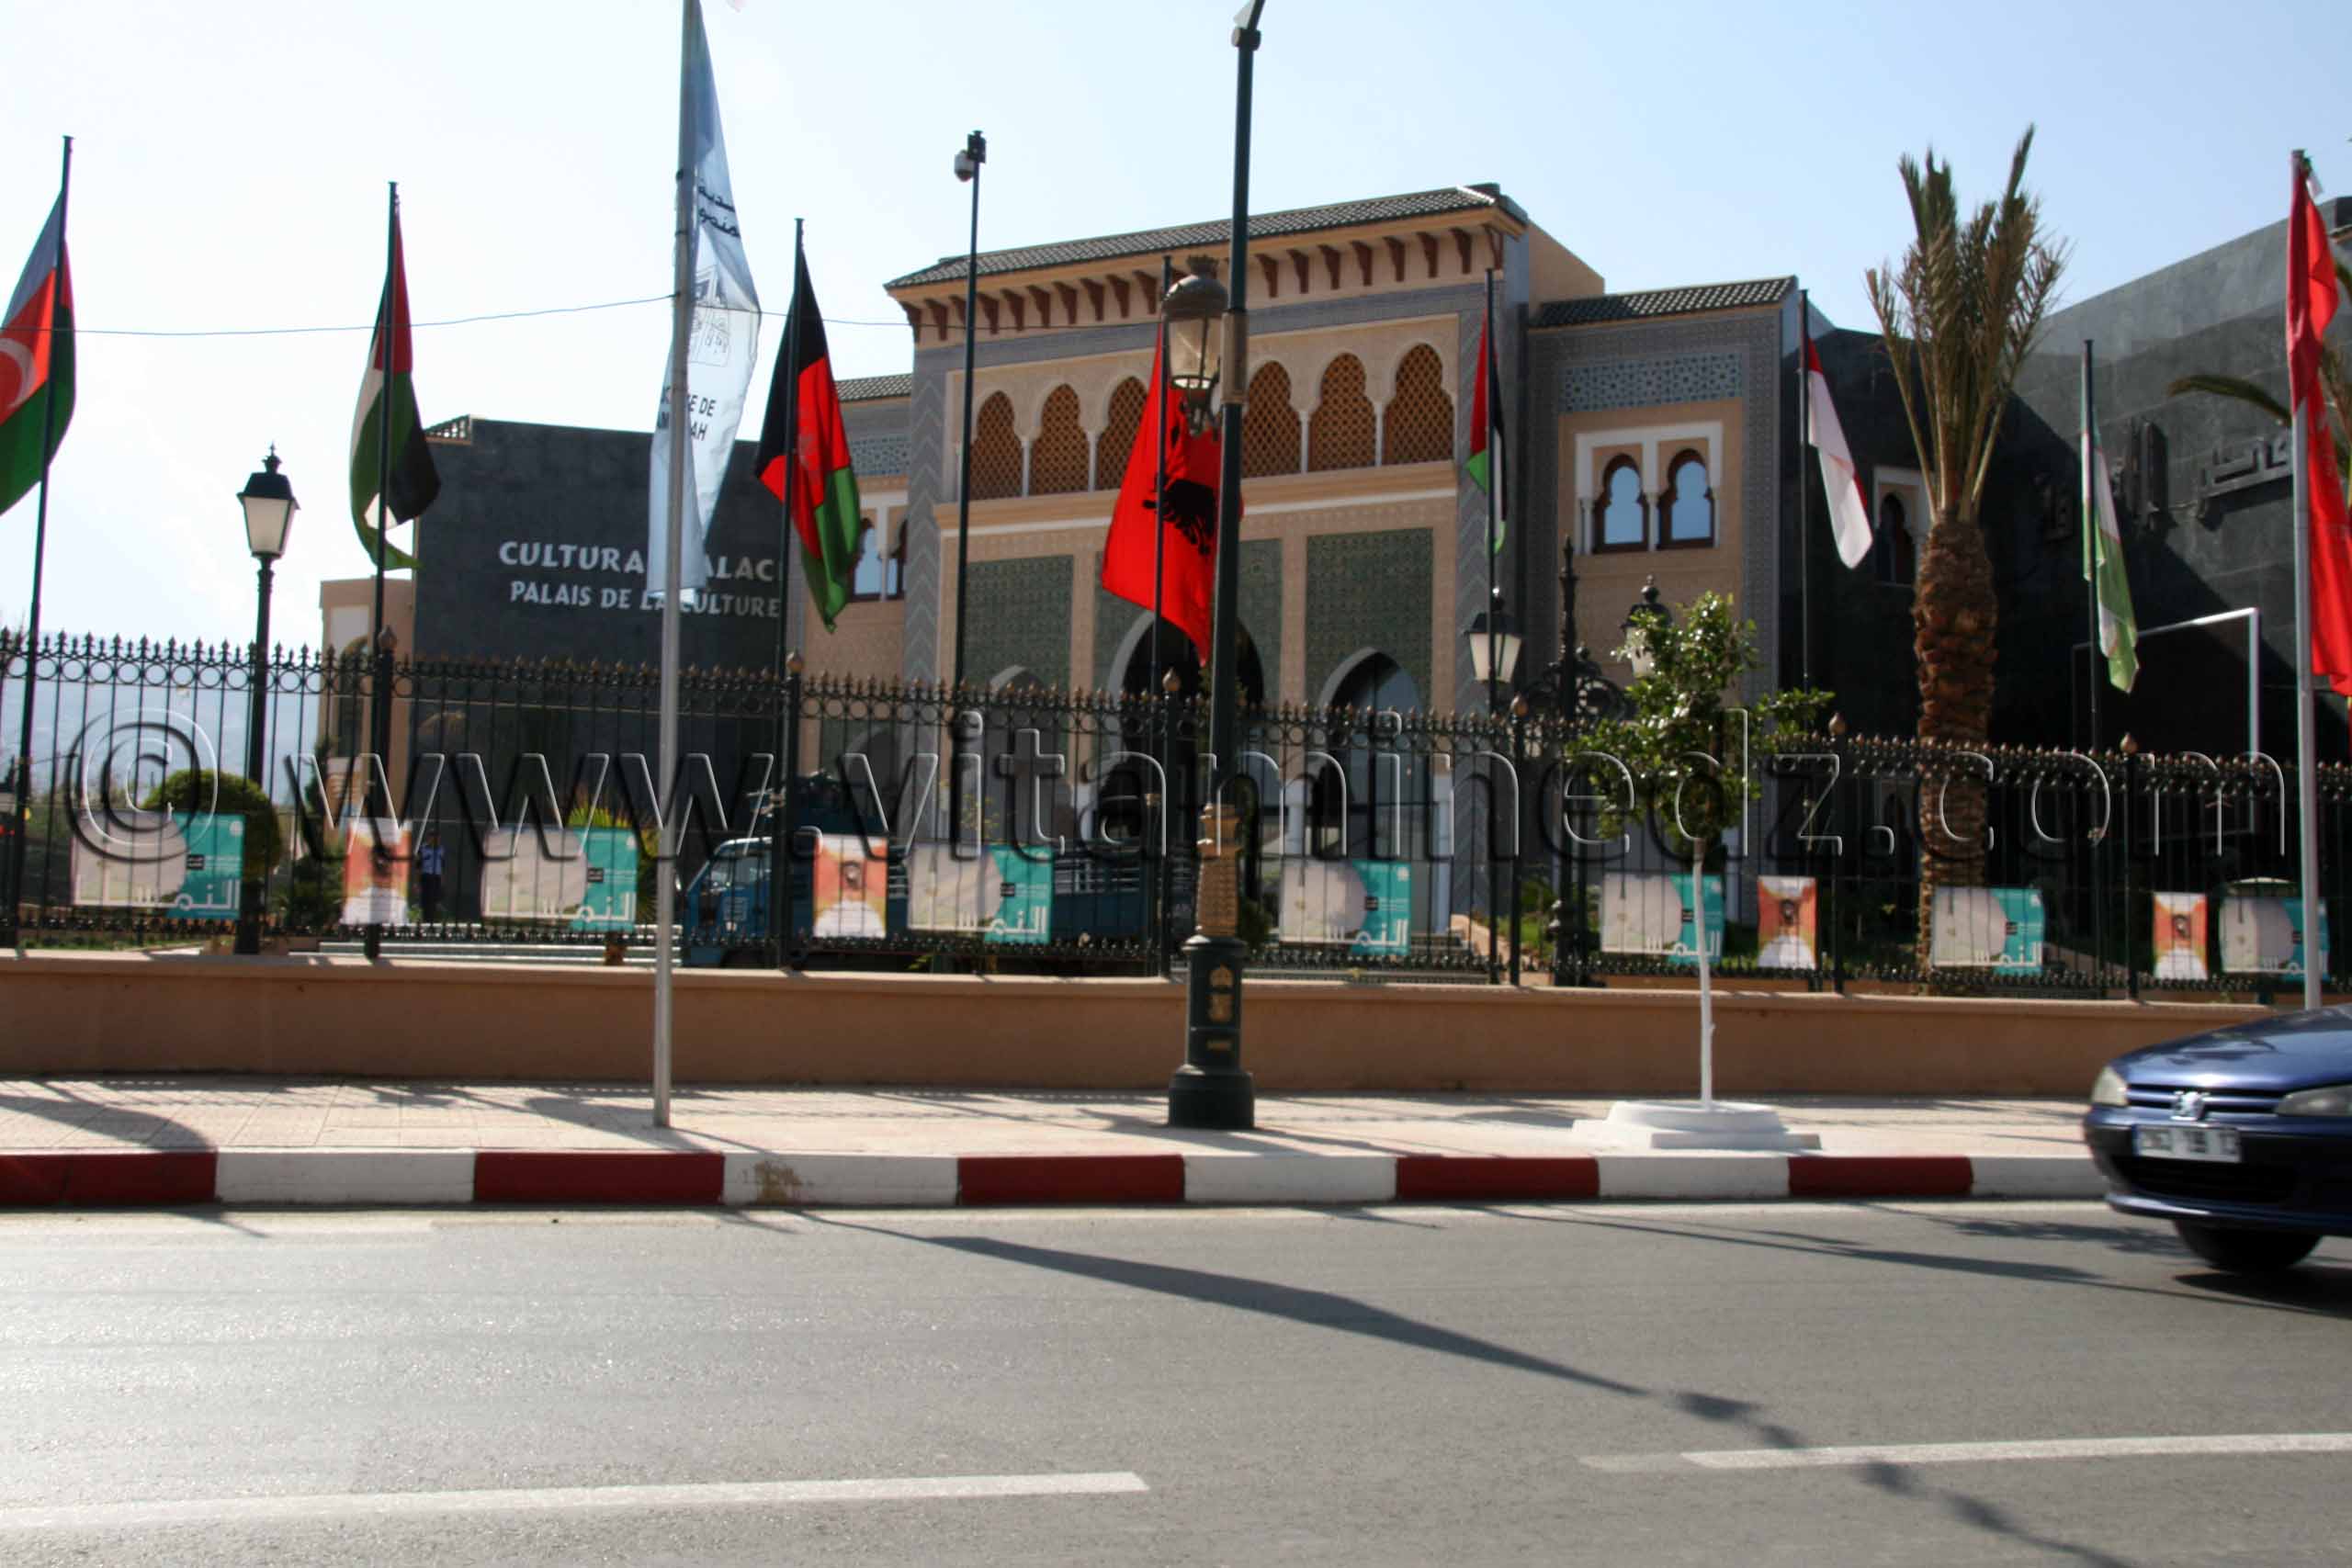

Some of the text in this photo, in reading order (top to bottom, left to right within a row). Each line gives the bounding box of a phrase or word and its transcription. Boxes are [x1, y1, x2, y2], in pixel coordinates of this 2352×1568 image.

[499, 540, 775, 581] CULTURA ALAC
[510, 580, 592, 606] PALAIS
[601, 587, 632, 609] DE
